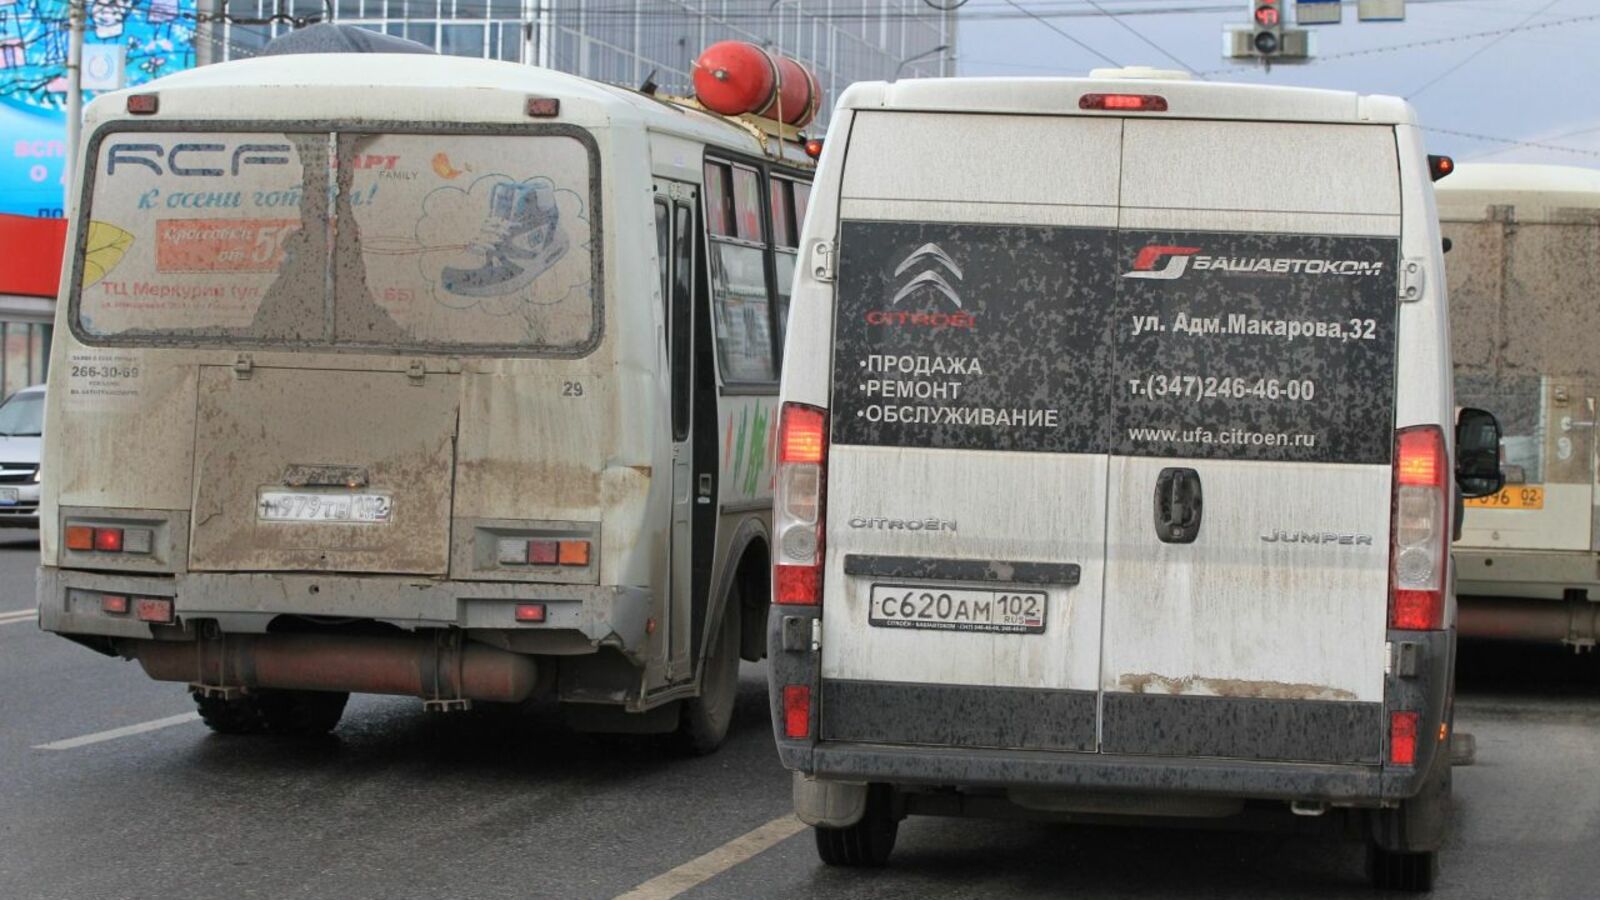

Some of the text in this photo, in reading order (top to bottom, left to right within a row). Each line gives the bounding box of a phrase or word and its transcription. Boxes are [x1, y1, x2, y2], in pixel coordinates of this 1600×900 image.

[379, 170, 418, 181] FAMILY
[1192, 256, 1383, 276] БАШАВТОКОМ
[102, 281, 128, 297] ТЦ
[1132, 312, 1377, 342] ул. Адм.Макарова,32
[72, 366, 139, 378] 266-30-69
[868, 355, 983, 376] ПРОДАЖА
[562, 381, 583, 396] 29
[866, 380, 962, 399] РЕМОНТ
[1128, 375, 1315, 401] т.(347)246-46-00
[865, 405, 1059, 427] ОБСЛУЖИВАНИЕ
[1128, 426, 1315, 447] www.ufa.citroen.ru
[1521, 489, 1537, 502] 02
[1260, 528, 1373, 545] JUMPER
[997, 595, 1036, 616] 102
[1004, 615, 1025, 624] RUS
